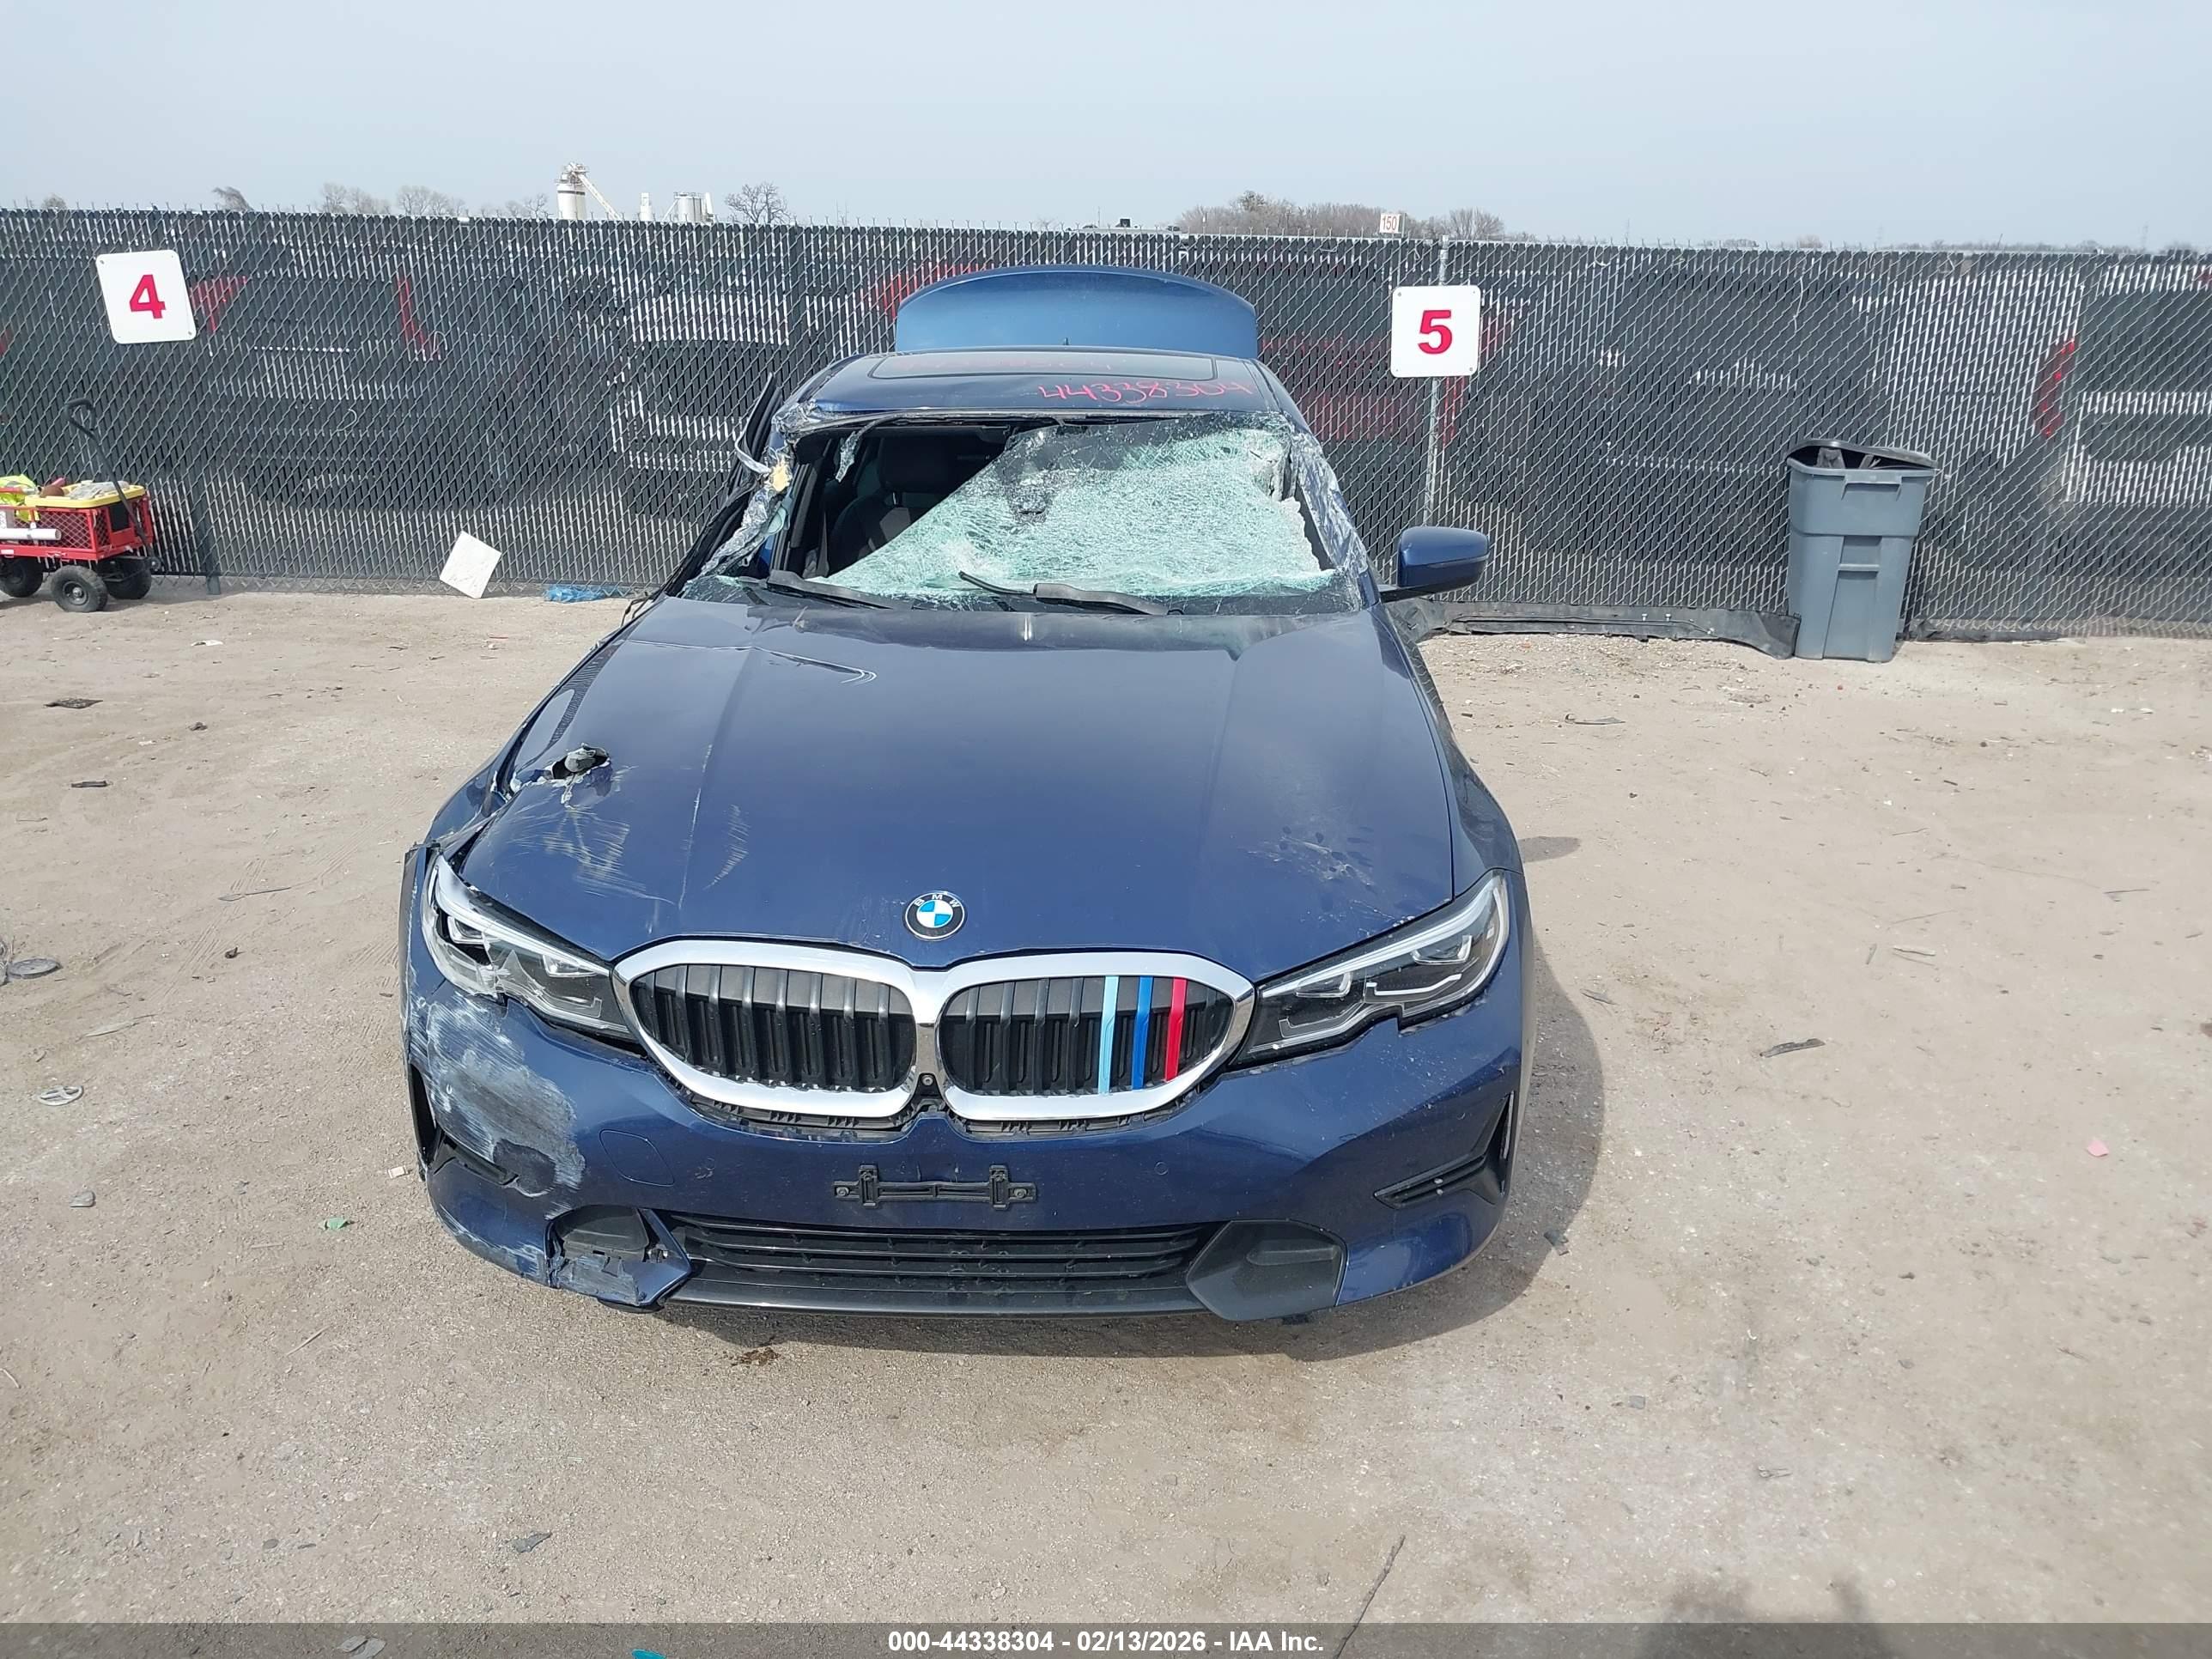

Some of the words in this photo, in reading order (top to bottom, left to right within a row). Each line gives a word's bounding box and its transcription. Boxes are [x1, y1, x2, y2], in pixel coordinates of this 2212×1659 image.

[1382, 216, 1397, 231] 150
[130, 274, 166, 319] 4
[1418, 309, 1453, 355] 5
[914, 894, 960, 908] BMW
